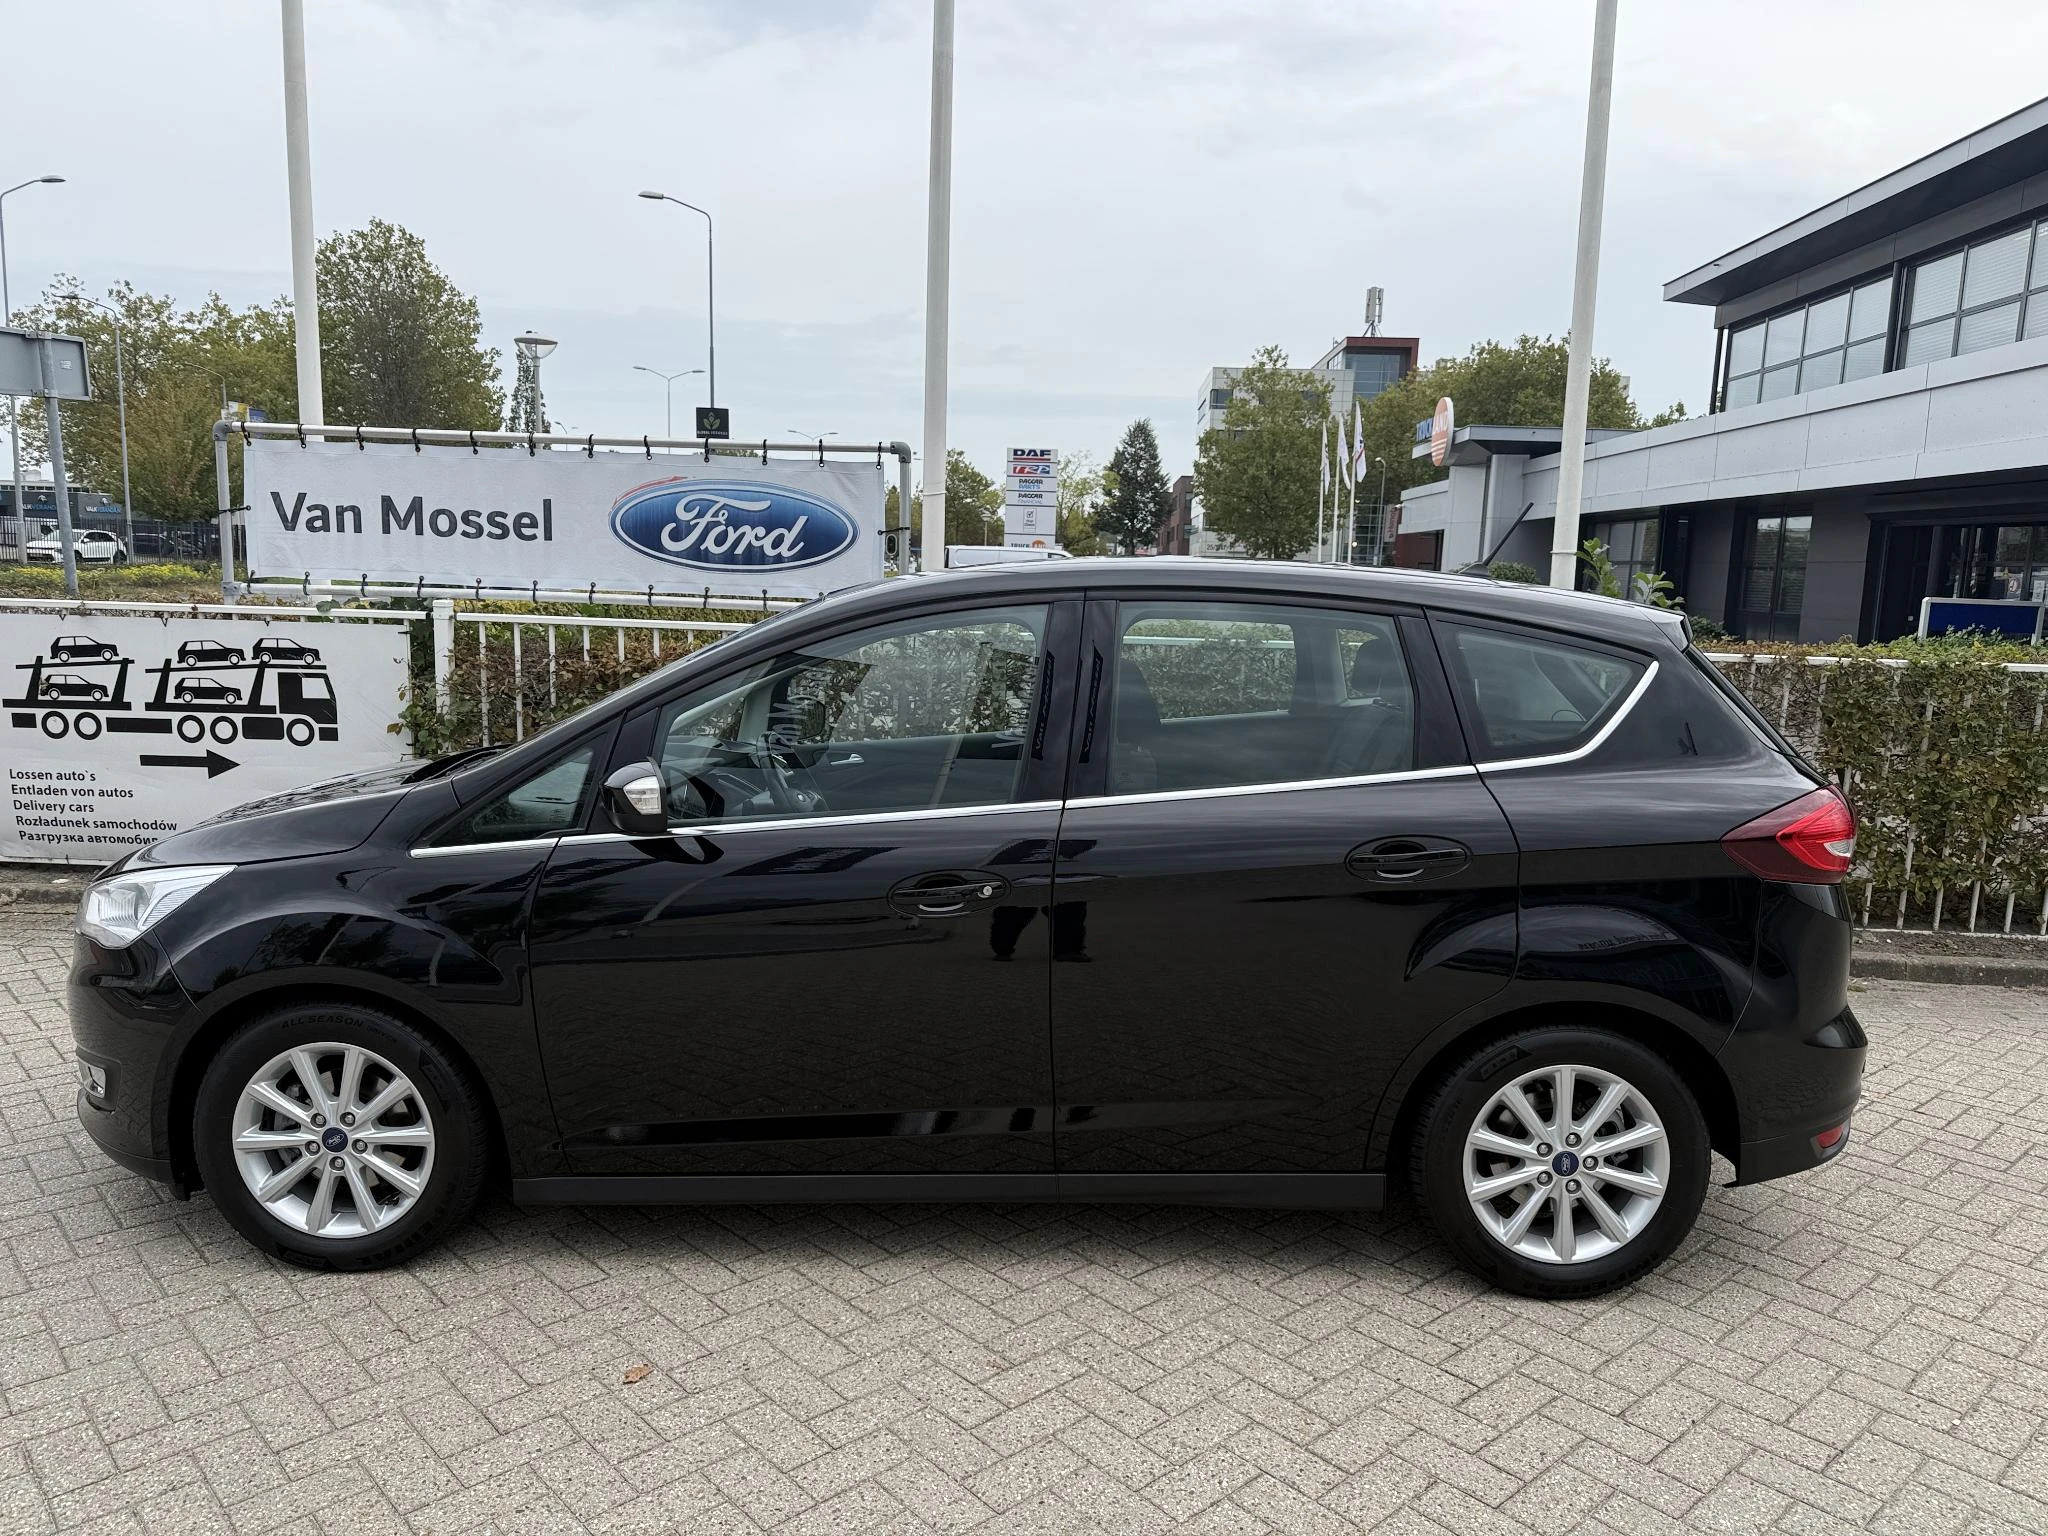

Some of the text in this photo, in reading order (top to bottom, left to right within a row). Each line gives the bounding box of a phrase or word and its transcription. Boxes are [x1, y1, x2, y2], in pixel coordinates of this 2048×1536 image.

[1013, 449, 1051, 457] DAF
[270, 491, 553, 542] Van Mossel
[661, 494, 808, 558] Ford
[9, 768, 53, 781] Lossen
[11, 783, 134, 798] Entladen von autos
[13, 800, 95, 814] Delivery cars
[16, 815, 177, 831] Rozładunek samochodów
[19, 830, 85, 845] Разгрузка
[281, 1017, 304, 1029] ALL
[308, 1015, 364, 1028] SEASON
